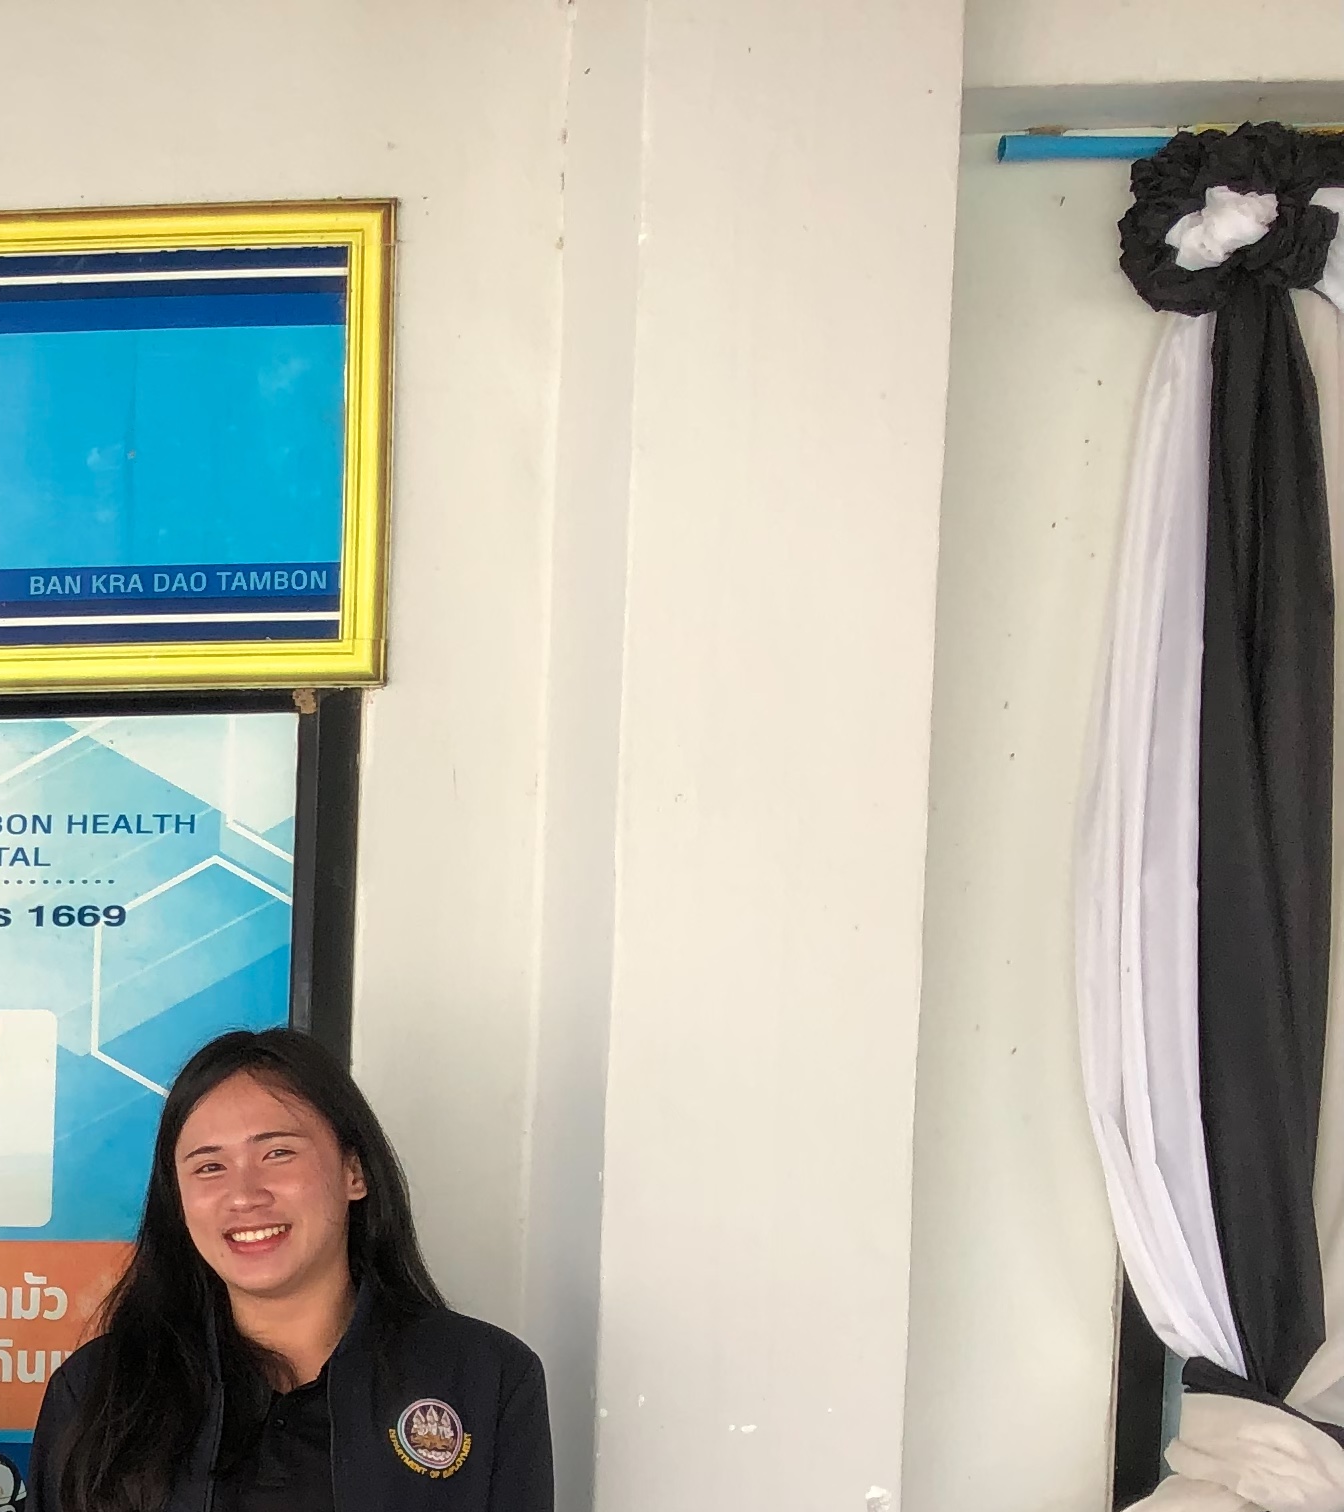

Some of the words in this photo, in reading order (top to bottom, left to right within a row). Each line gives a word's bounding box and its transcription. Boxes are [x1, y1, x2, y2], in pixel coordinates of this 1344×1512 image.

[29, 575, 81, 595] BAN
[91, 573, 144, 594] KRA
[153, 571, 207, 592] DAO
[215, 569, 328, 591] TAMBON
[66, 813, 197, 834] HEALTH
[29, 904, 128, 928] 1669
